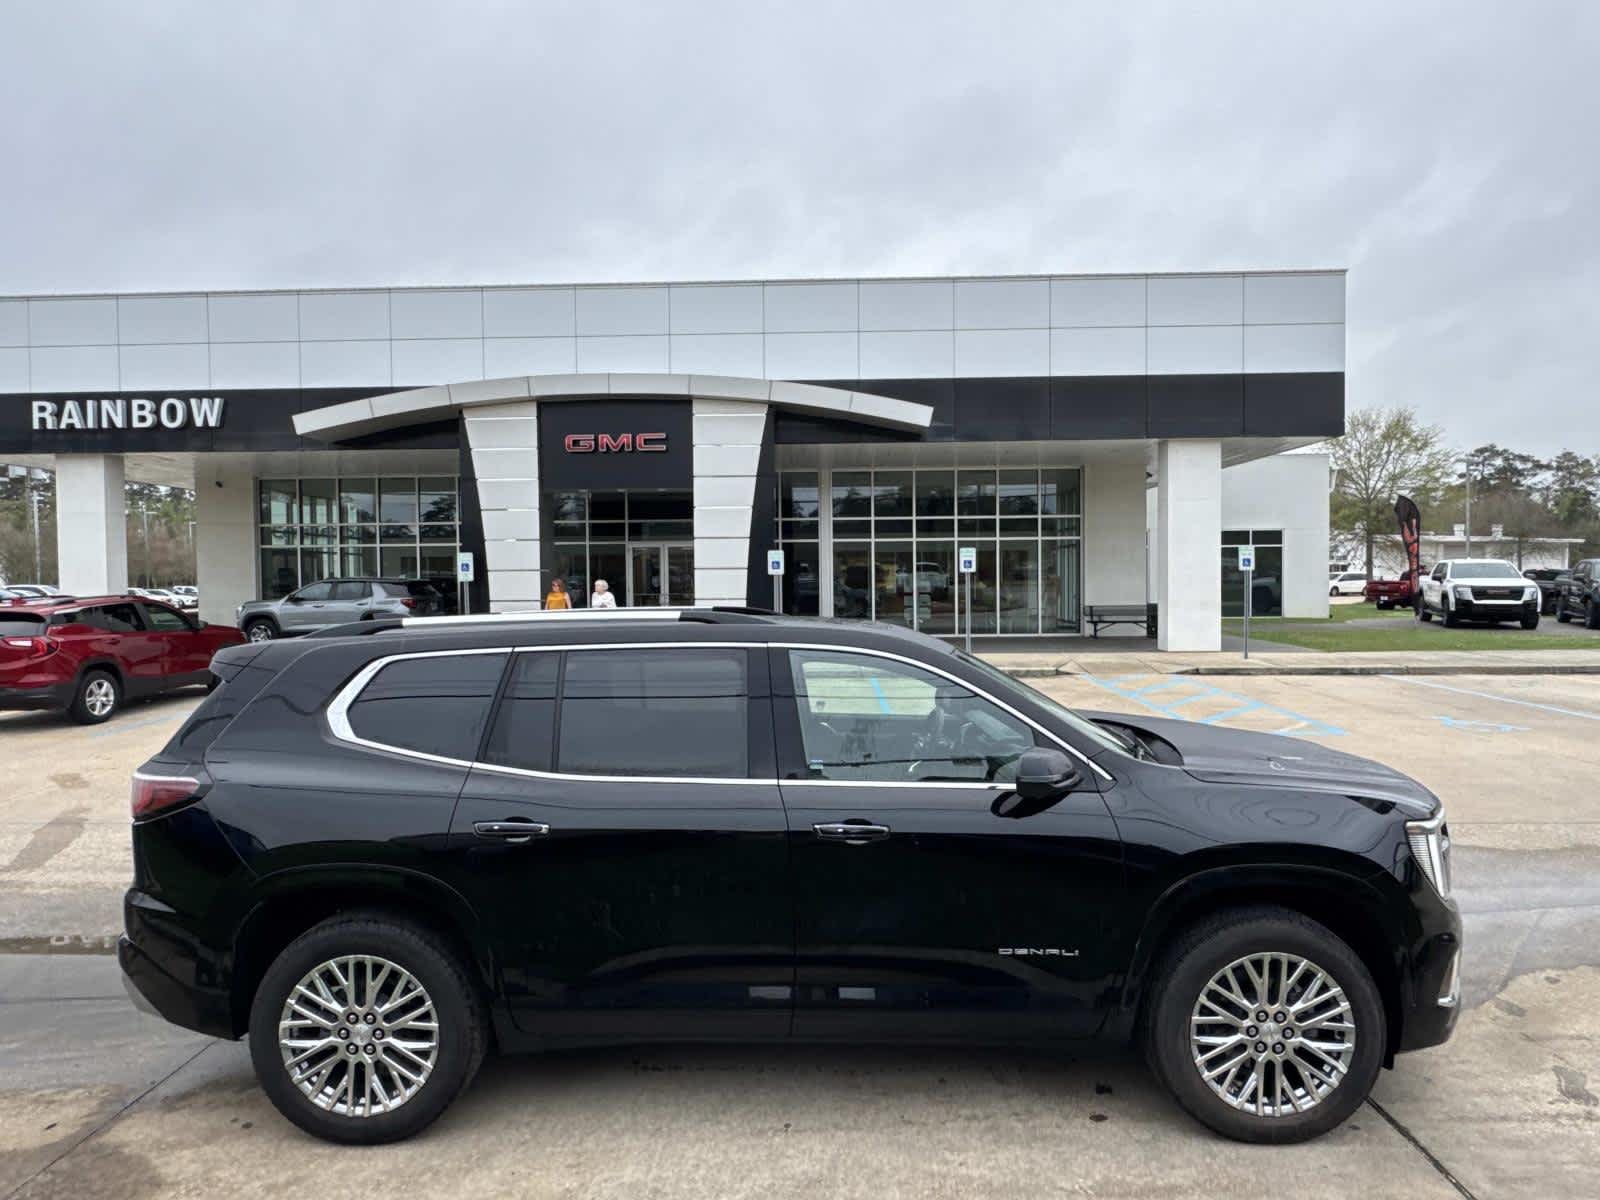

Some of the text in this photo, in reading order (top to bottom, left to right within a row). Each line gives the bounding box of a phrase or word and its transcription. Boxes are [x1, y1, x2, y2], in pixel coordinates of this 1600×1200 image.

[31, 398, 224, 429] RAINBOW
[565, 432, 667, 452] GMC
[998, 947, 1079, 956] DENALI
